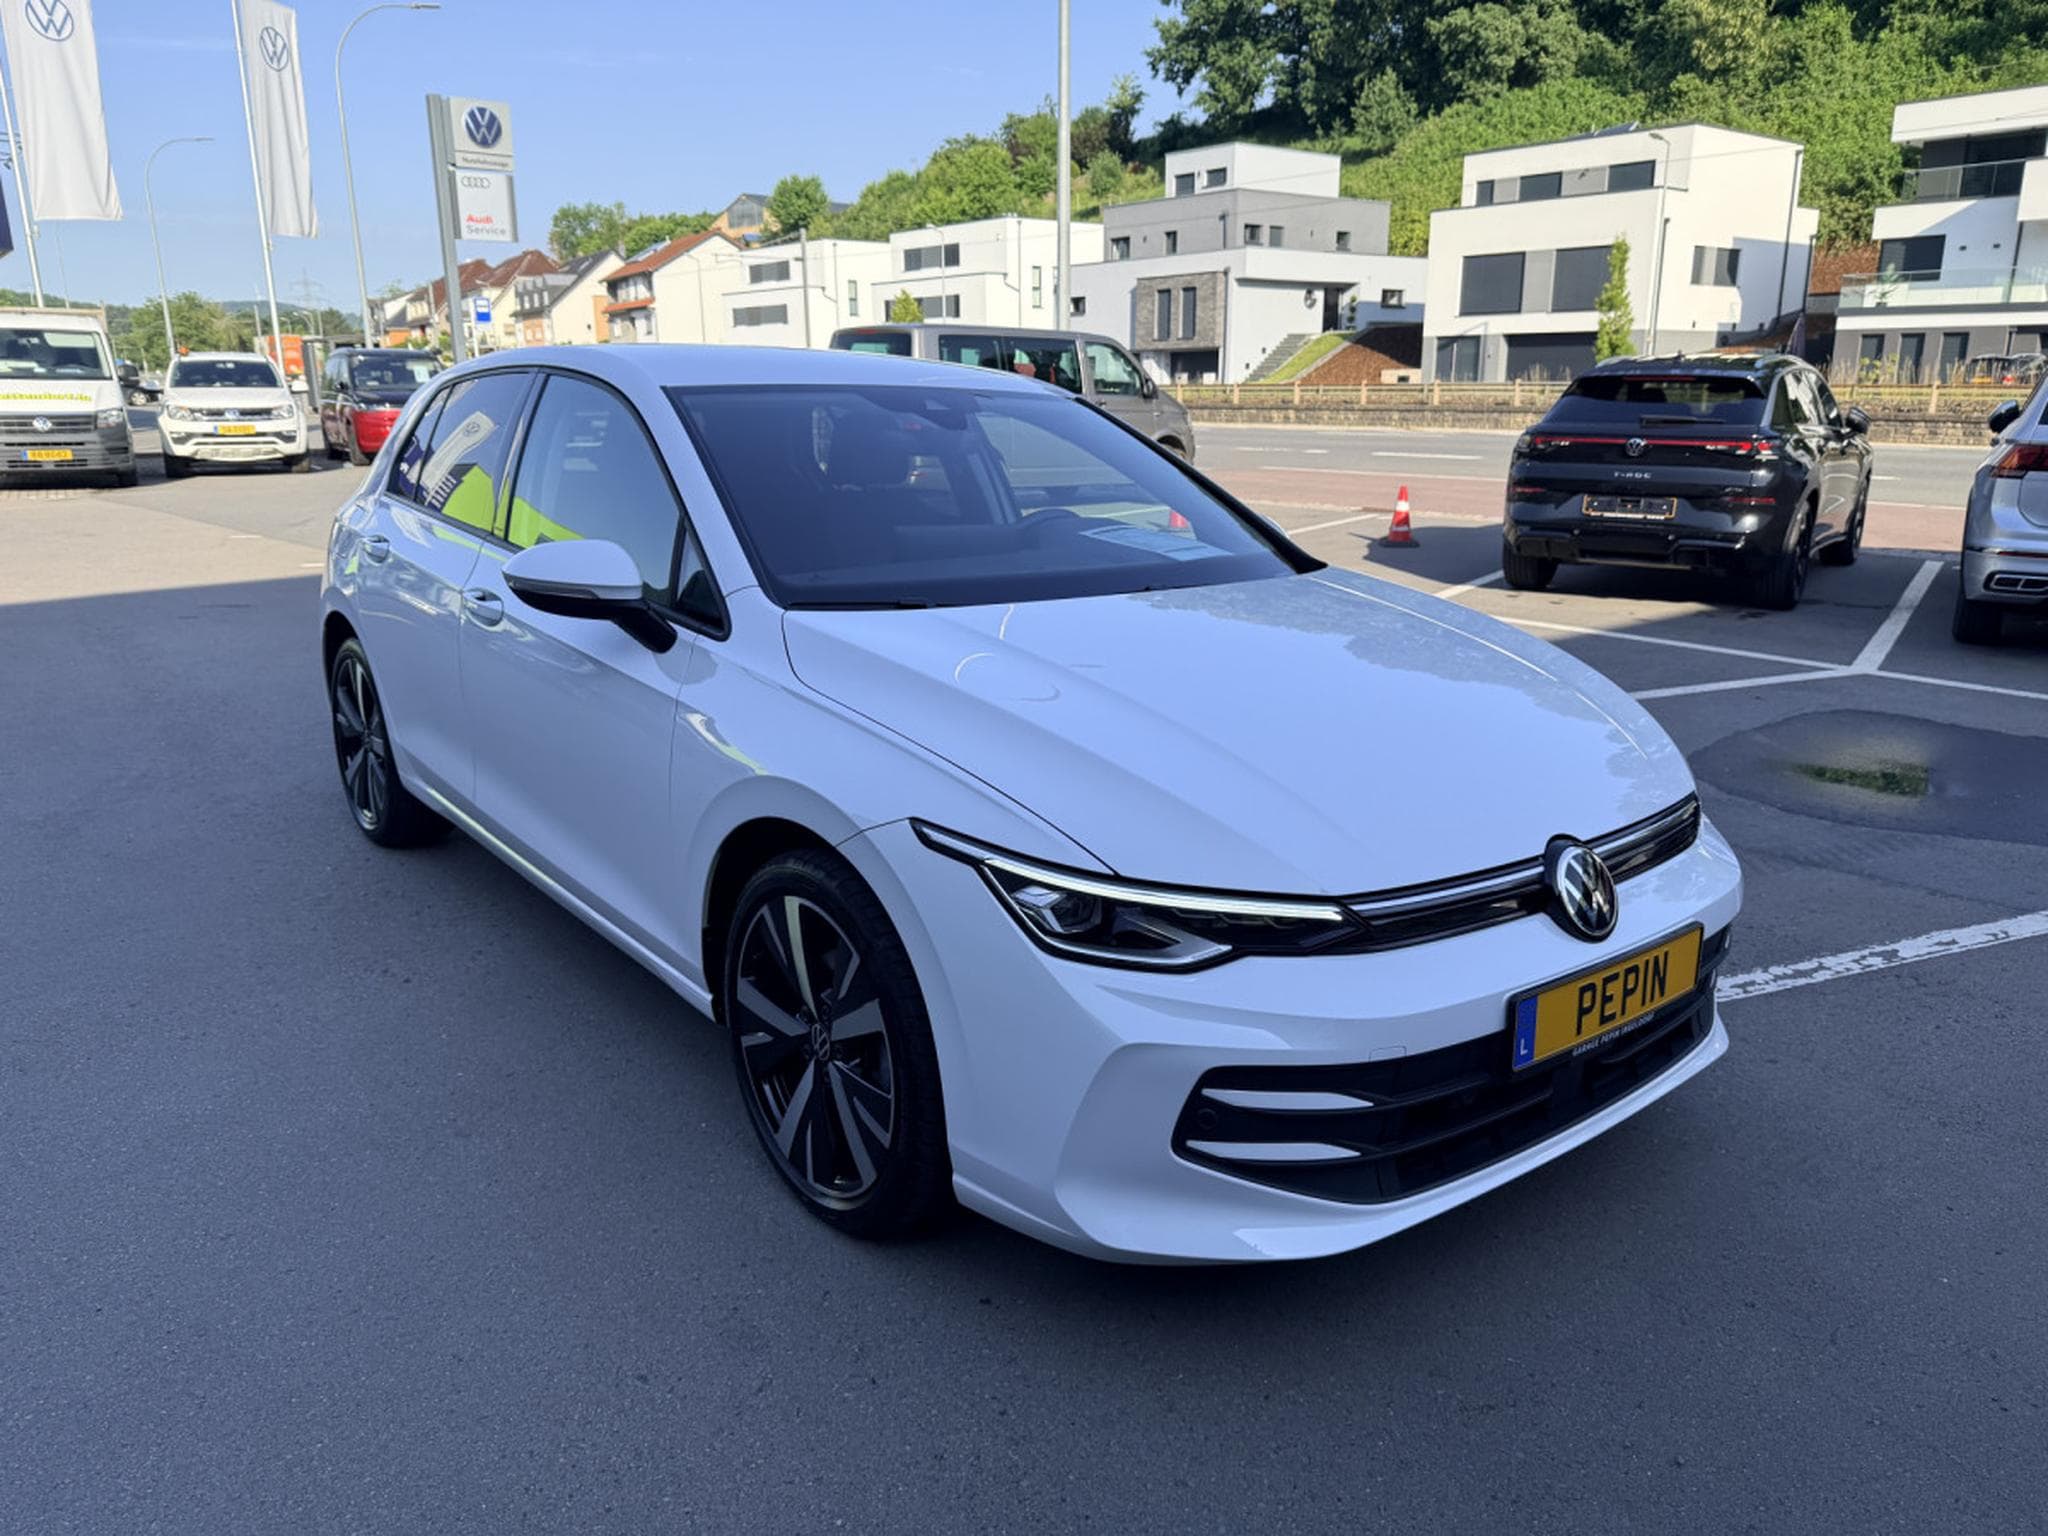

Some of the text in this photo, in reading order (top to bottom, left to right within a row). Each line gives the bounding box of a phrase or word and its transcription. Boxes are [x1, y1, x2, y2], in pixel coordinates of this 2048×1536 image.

[259, 26, 289, 72] VW
[463, 106, 502, 148] VW
[466, 225, 505, 235] Service
[467, 214, 493, 224] Audi
[1556, 845, 1616, 937] VW
[1576, 951, 1668, 1036] PEPIN
[1519, 1037, 1528, 1056] L
